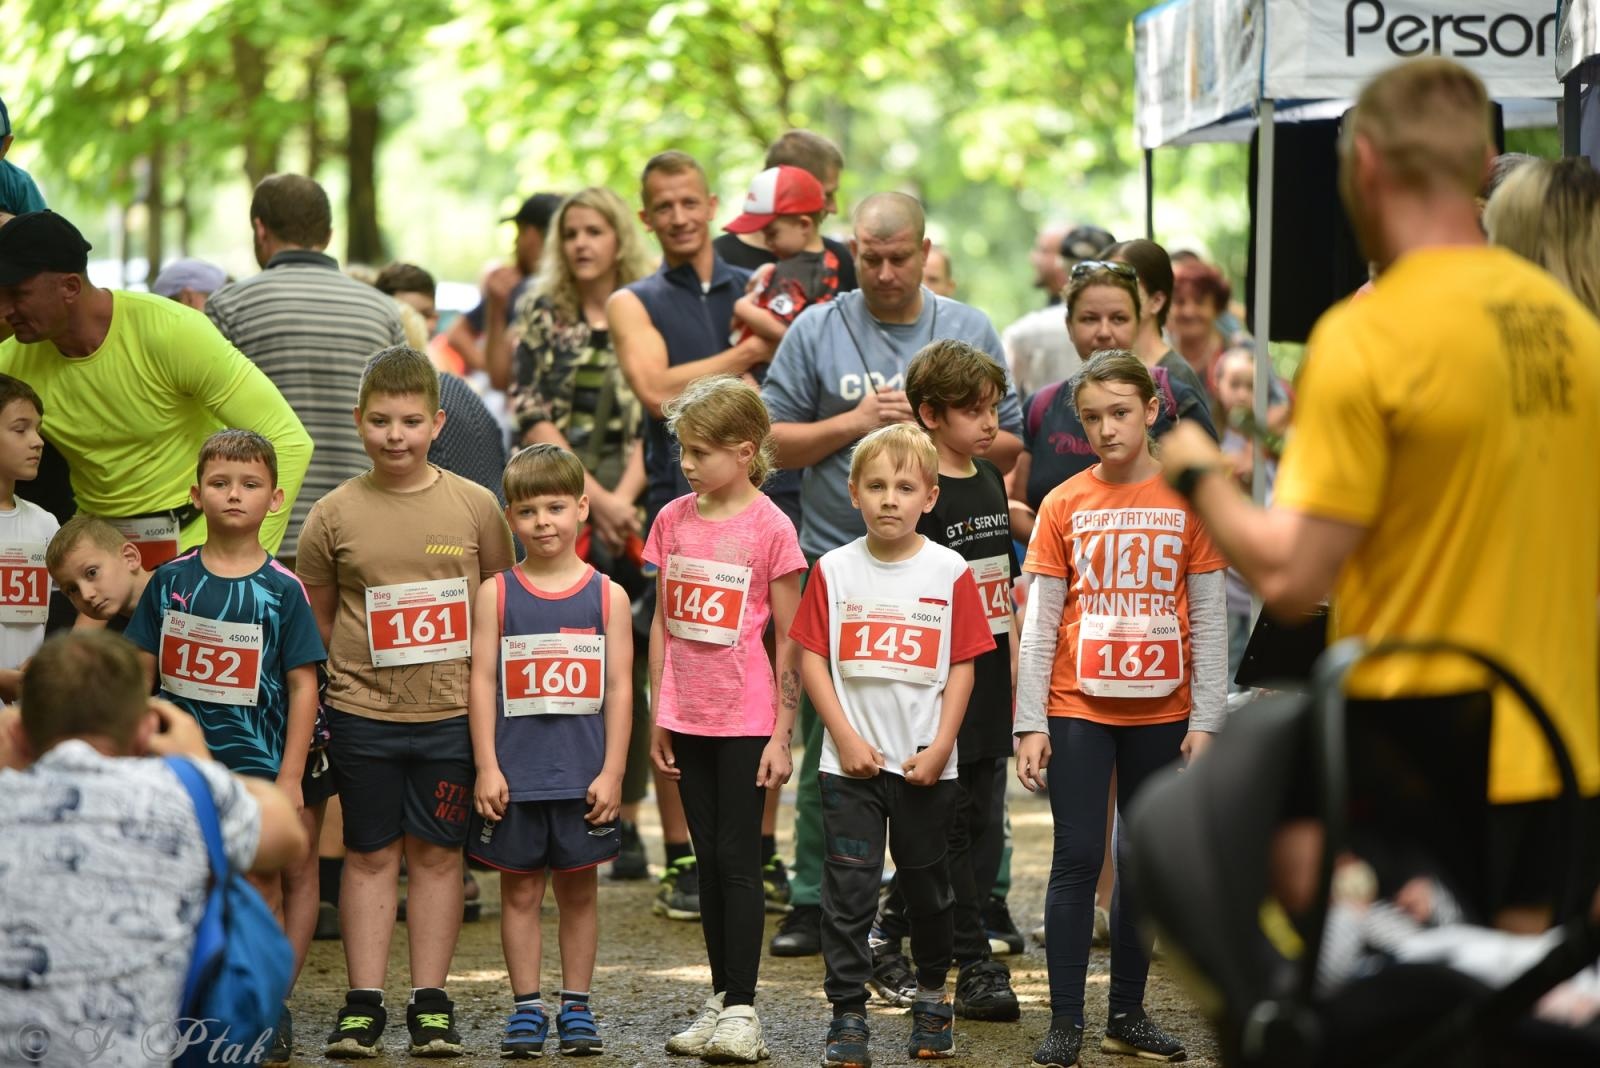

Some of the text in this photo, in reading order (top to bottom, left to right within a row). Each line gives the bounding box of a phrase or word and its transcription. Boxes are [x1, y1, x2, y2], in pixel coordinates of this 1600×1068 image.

[1076, 511, 1182, 529] CHARYTATYWNE
[145, 528, 165, 537] 4500
[1071, 533, 1183, 592] KIDS
[715, 573, 745, 585] 4500 M
[440, 589, 458, 598] 4500
[458, 588, 465, 596] M
[673, 584, 725, 623] 146
[388, 606, 456, 646] 161
[911, 612, 932, 623] 4500
[933, 615, 942, 624] M
[229, 634, 259, 643] 4500 M
[1151, 626, 1169, 635] 4500
[1169, 626, 1177, 635] M
[573, 644, 592, 654] 4500
[592, 646, 600, 654] M
[854, 624, 923, 662] 145
[175, 643, 242, 685] 152
[1097, 643, 1166, 677] 162
[521, 661, 587, 695] 160
